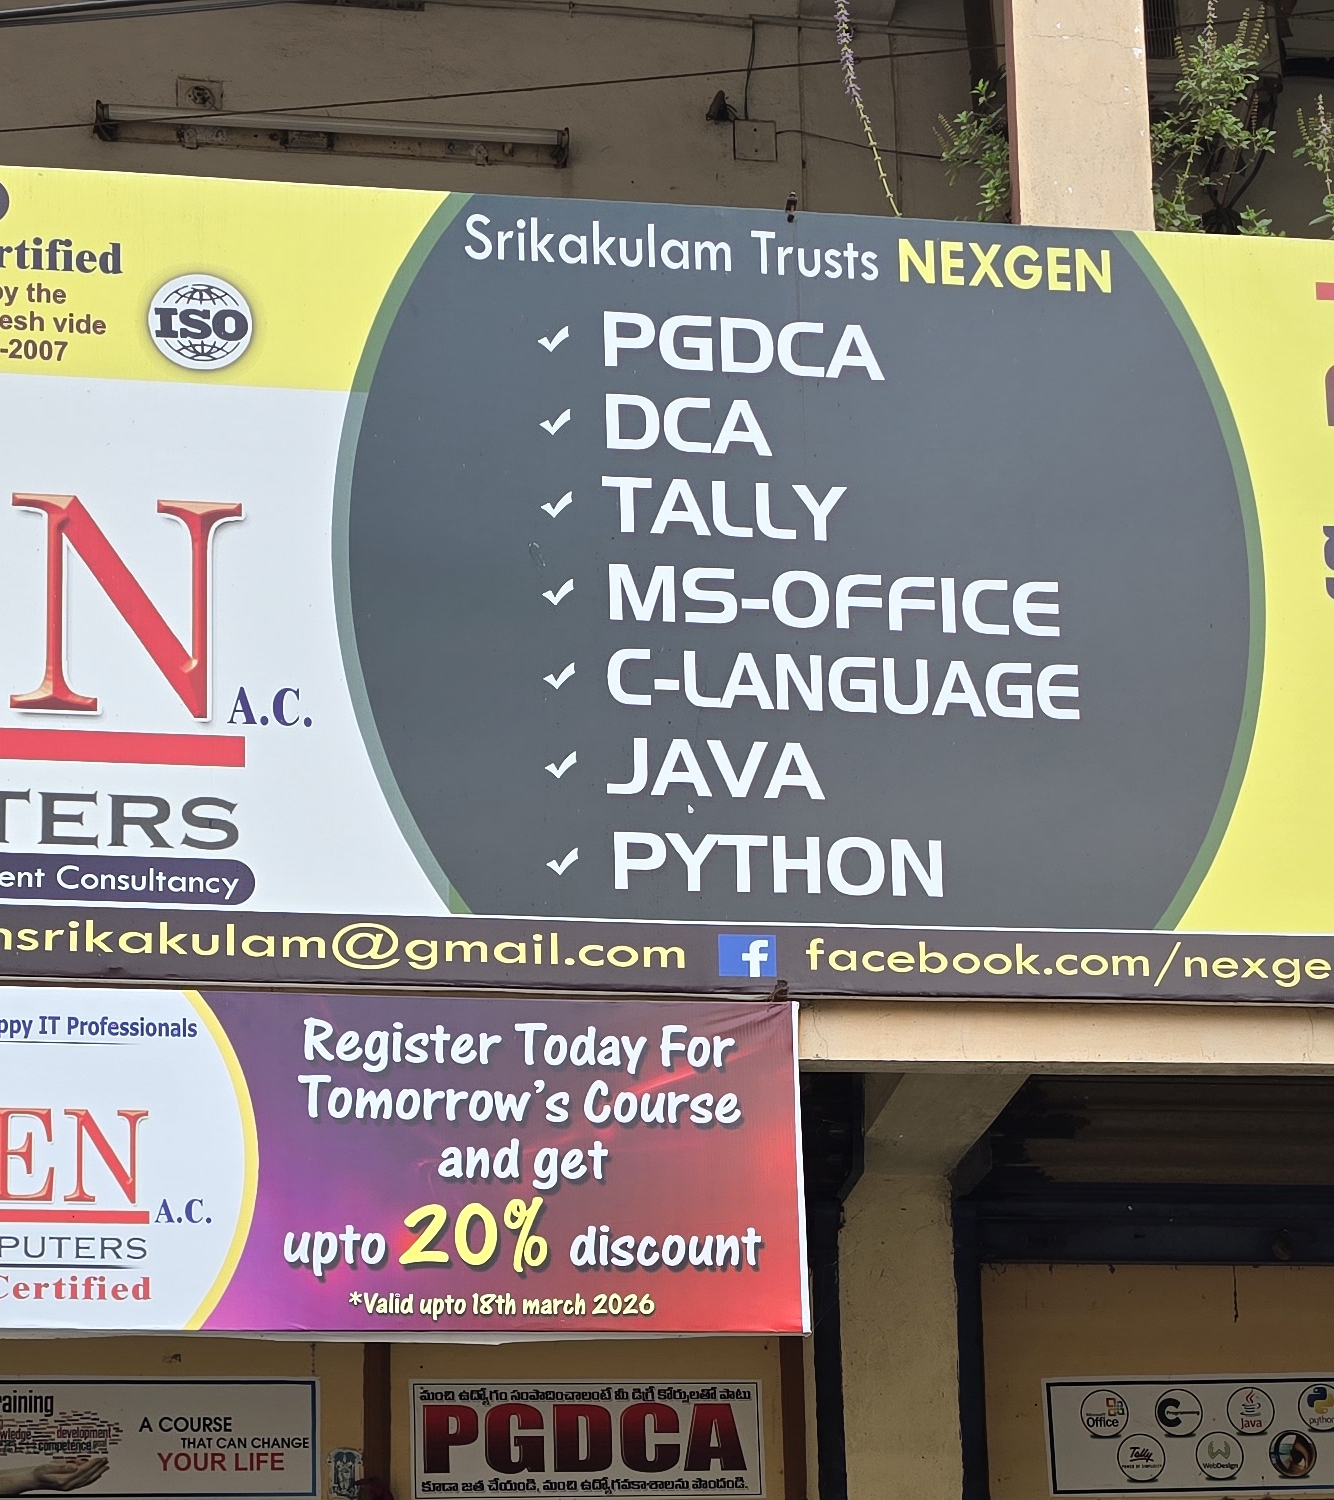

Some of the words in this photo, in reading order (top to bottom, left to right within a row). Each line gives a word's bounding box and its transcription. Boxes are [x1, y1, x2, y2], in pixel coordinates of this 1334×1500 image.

[464, 213, 733, 274] Srikakulam
[751, 230, 879, 282] Trusts
[897, 238, 1112, 293] NEXGEN
[154, 306, 249, 342] ISO
[603, 311, 885, 381] PGDCA
[605, 392, 772, 457] DCA
[601, 475, 847, 542] TALLY
[608, 563, 1060, 638] MS-OFFICE
[227, 686, 313, 728] A.C.
[606, 648, 1080, 720] C-LANGUAGE
[606, 737, 826, 799] JAVA
[56, 864, 240, 896] Consultancy
[614, 831, 944, 899] PYTHON
[39, 1016, 60, 1034] IT
[67, 1016, 197, 1038] Professionals
[303, 1017, 501, 1071] Register
[514, 1022, 645, 1073] Today
[659, 1024, 736, 1070] For
[583, 1081, 741, 1126] Course
[437, 1137, 520, 1181] and
[533, 1141, 608, 1192] get
[283, 1224, 386, 1278] upto
[398, 1198, 549, 1272] 20%
[570, 1224, 762, 1269] discount
[419, 1294, 467, 1321] upto
[473, 1292, 516, 1317] 18th
[522, 1293, 587, 1317] march
[594, 1293, 655, 1317] 2026
[158, 1452, 226, 1471] YOUR
[235, 1452, 285, 1471] LIFE
[423, 1403, 748, 1473] PGDCA
